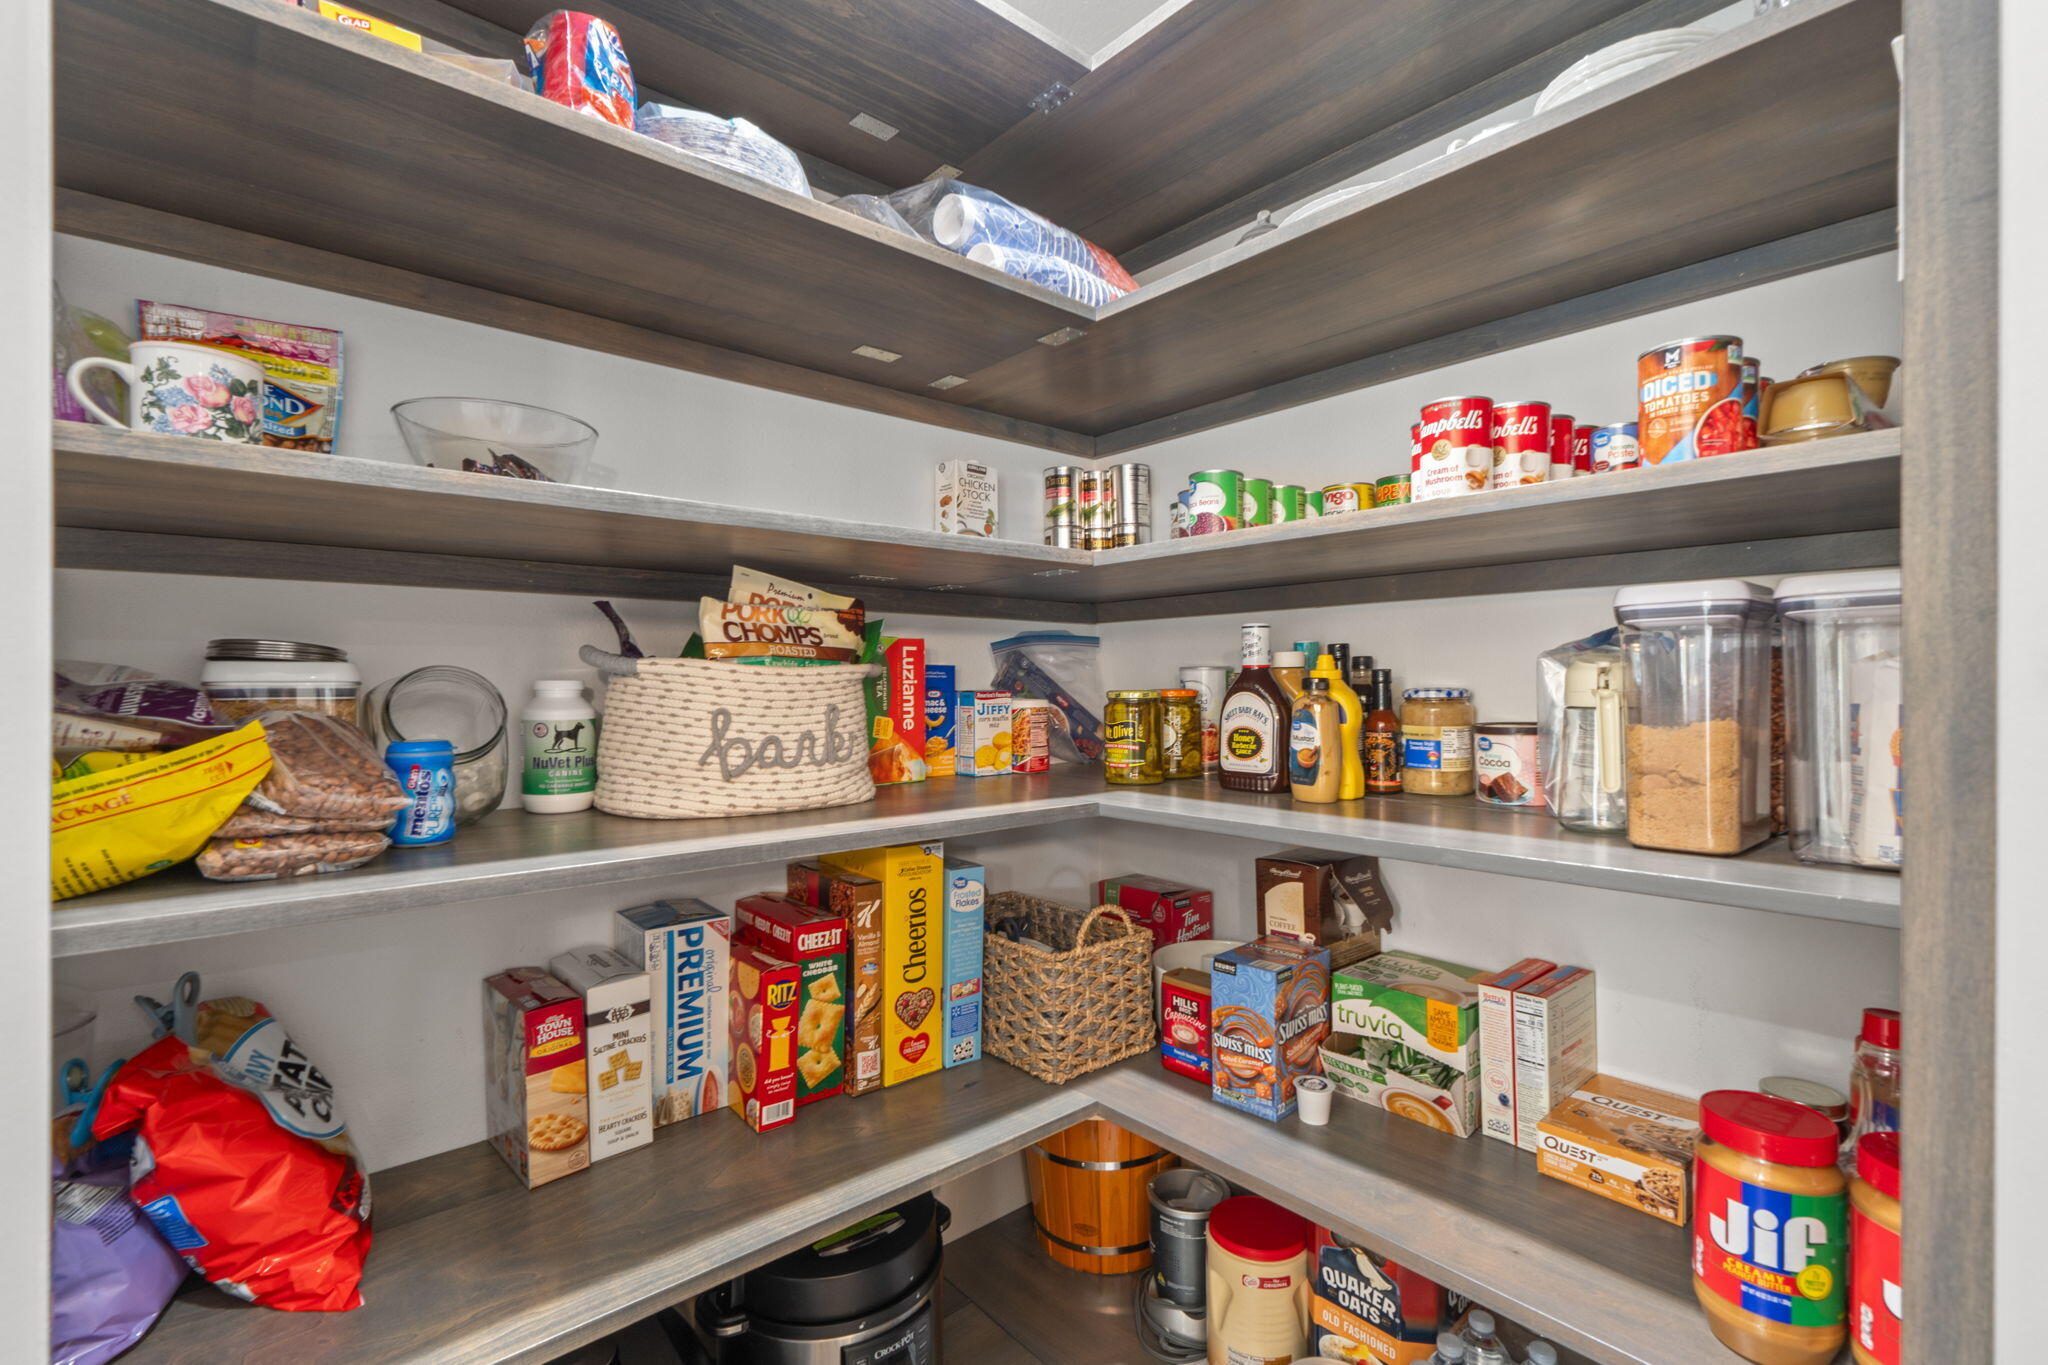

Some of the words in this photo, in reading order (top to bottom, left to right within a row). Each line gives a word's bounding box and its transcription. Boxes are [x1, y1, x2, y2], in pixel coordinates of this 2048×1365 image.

[337, 14, 370, 30] GLAD
[1643, 370, 1713, 402] DICED
[1644, 391, 1710, 413] TOMATOES
[1425, 474, 1463, 485] Mushroom
[1427, 467, 1449, 477] Cream
[958, 477, 996, 492] CHICKEN
[962, 488, 991, 502] STOCK
[767, 582, 805, 601] Premium
[721, 603, 788, 624] PORK
[722, 621, 824, 646] CHOMPS
[768, 644, 817, 657] ROASTED
[901, 645, 918, 731] Luzianne
[977, 703, 1011, 716] JIFFY
[1224, 708, 1239, 723] SWEET
[1238, 706, 1252, 715] BABY
[1252, 708, 1268, 725] RAY'S
[1113, 725, 1134, 739] Olive
[1233, 734, 1255, 744] Honey
[698, 703, 852, 782] bark
[532, 756, 571, 769] NuVet
[1479, 757, 1511, 768] Cocoa
[548, 769, 583, 777] CANINE
[409, 769, 432, 838] mentos
[953, 888, 982, 900] Frosted
[955, 899, 980, 907] Flakes
[1182, 909, 1200, 926] Tim
[1269, 920, 1297, 931] COFFEE
[902, 886, 927, 985] Cheerios
[1176, 922, 1211, 943] Hortons
[705, 949, 722, 993] original
[808, 960, 833, 970] WHITE
[1214, 961, 1236, 973] KEURIG
[767, 981, 797, 1006] RITZ
[677, 926, 705, 1082] PREMIUM
[1172, 995, 1198, 1012] HILLS
[536, 1017, 572, 1035] TOWN
[1164, 1007, 1208, 1031] Cappuccino
[1336, 1003, 1405, 1041] truvia
[536, 1026, 575, 1045] HOUSE
[612, 1030, 630, 1039] MINI
[1278, 1014, 1306, 1045] SWISS
[617, 1033, 647, 1047] CRACKERS
[1213, 1032, 1242, 1052] SWISS
[1244, 1044, 1272, 1064] MISS
[1220, 1053, 1239, 1063] Salted
[1238, 1055, 1264, 1067] Caramel
[1591, 1096, 1667, 1121] QUEST
[598, 1121, 621, 1134] HEARTY
[621, 1110, 648, 1126] CRACKERS
[1544, 1135, 1597, 1163] QUEST
[1709, 1197, 1828, 1274] Jif
[1725, 1256, 1784, 1284] CREAMY
[1322, 1265, 1397, 1320] QUAKER
[1757, 1277, 1792, 1294] BUTTER
[1338, 1289, 1381, 1325] OATS
[1322, 1309, 1340, 1328] OLD
[1343, 1320, 1396, 1360] FASHIONED
